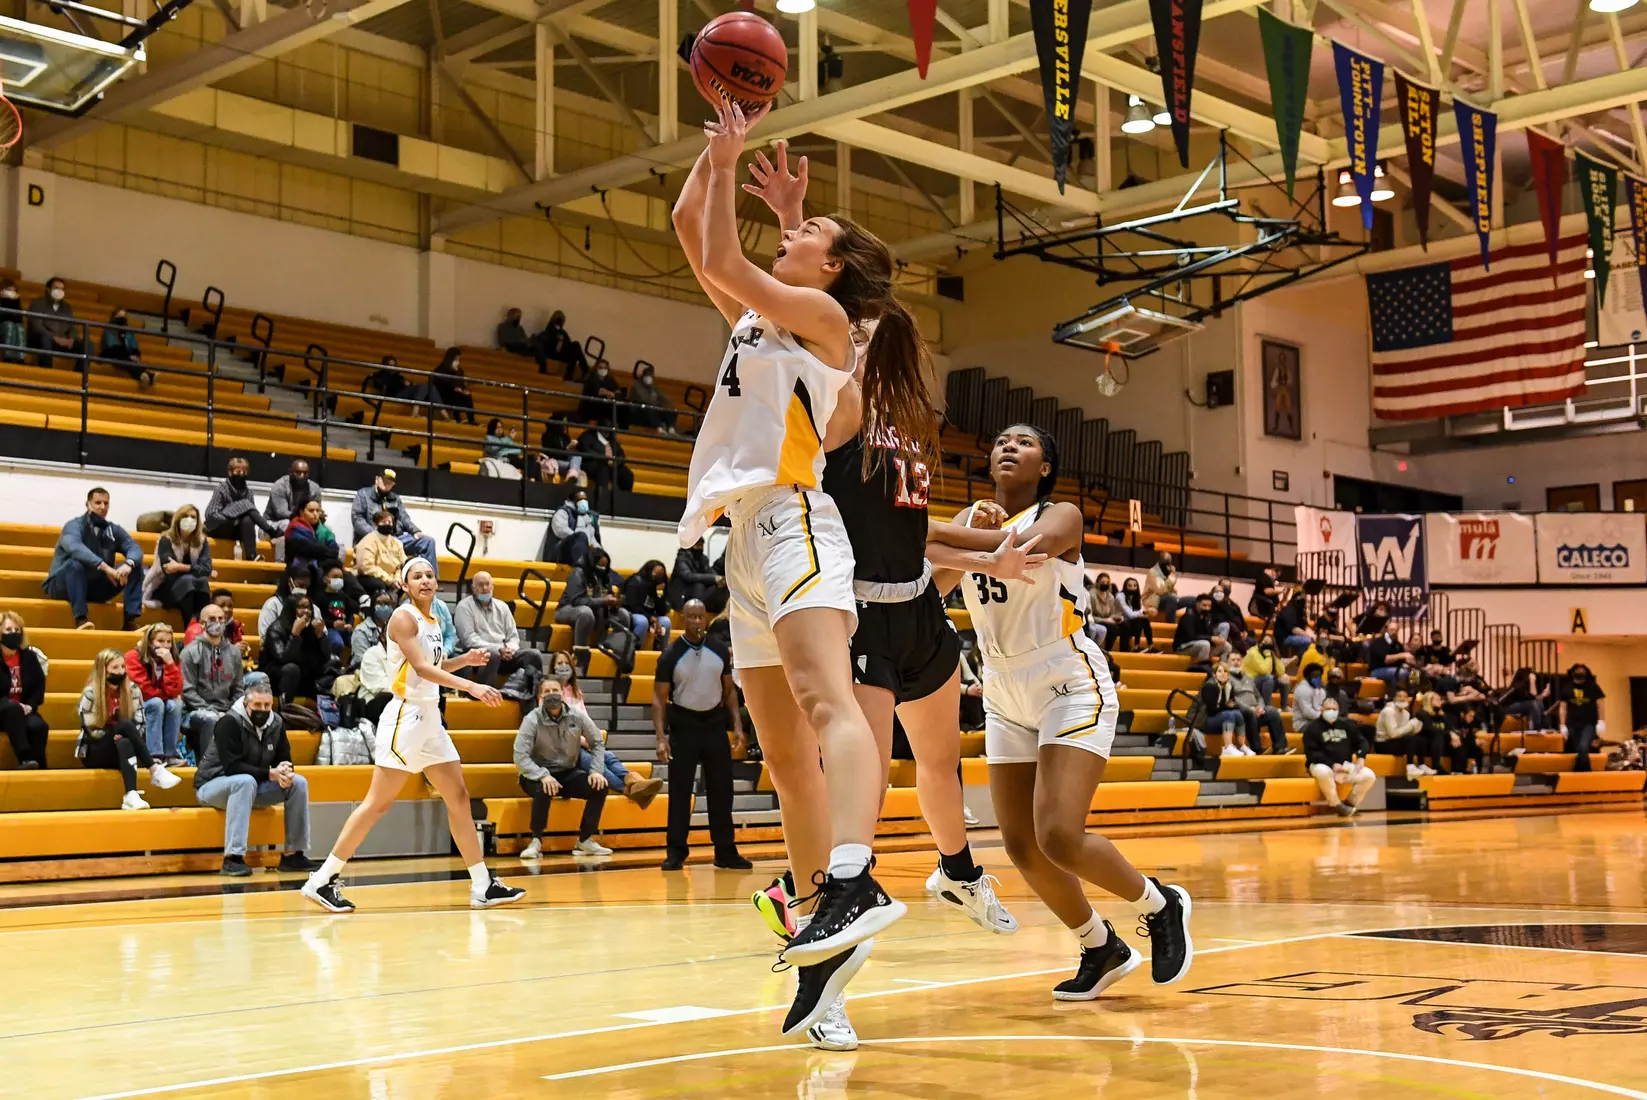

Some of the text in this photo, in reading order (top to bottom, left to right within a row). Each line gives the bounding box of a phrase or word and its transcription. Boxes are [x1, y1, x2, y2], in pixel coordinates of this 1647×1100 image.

[730, 60, 776, 92] NCAA
[1170, 0, 1188, 124] ANSFIELD
[1350, 56, 1367, 177] JOHNSTOWN
[1406, 82, 1421, 139] HILL
[1418, 89, 1433, 167] SETON
[1472, 113, 1490, 234] SHEPHERD
[27, 182, 45, 207] D
[720, 352, 742, 397] 4
[1131, 505, 1142, 532] A
[1558, 548, 1629, 568] CALECO
[972, 572, 1009, 605] 35
[1363, 586, 1423, 602] WEAVER
[1571, 608, 1587, 634] A
